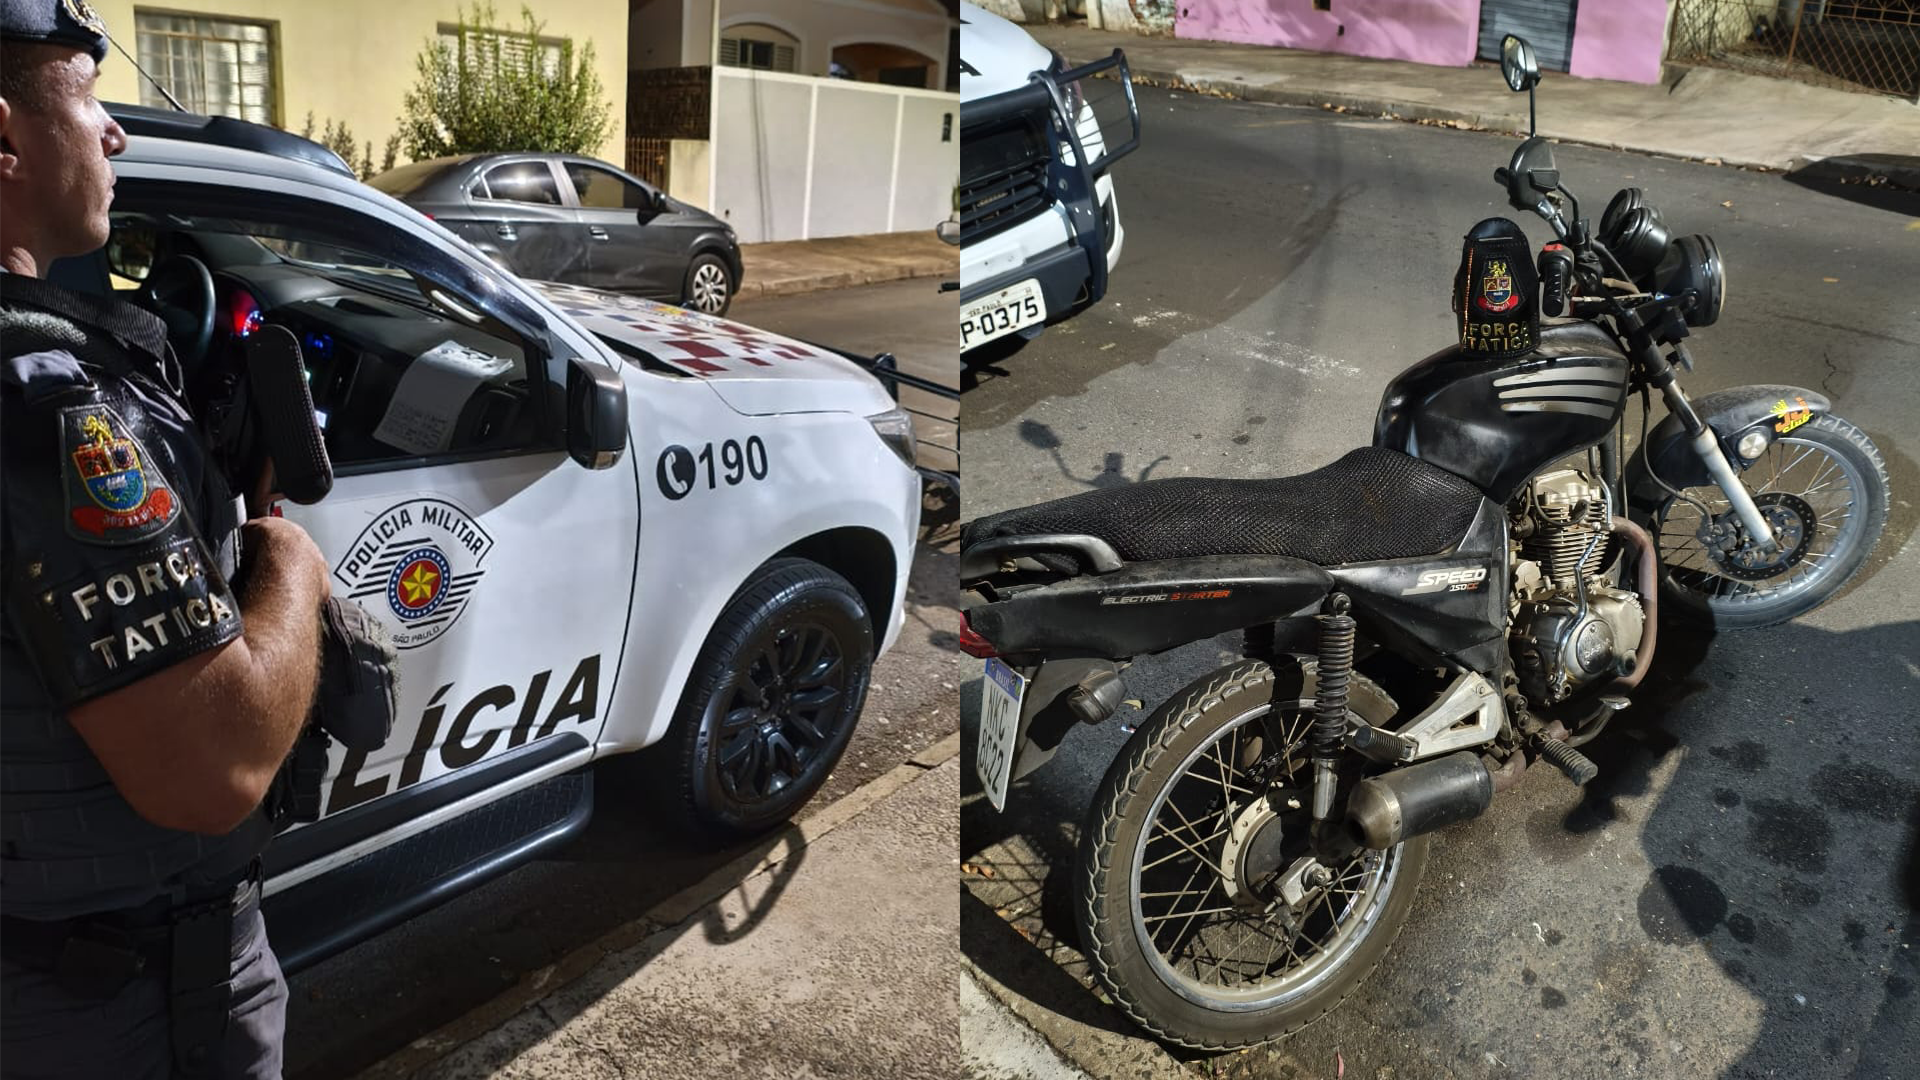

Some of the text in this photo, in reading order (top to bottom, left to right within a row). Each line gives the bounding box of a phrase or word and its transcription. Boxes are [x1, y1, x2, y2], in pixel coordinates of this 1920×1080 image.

[699, 435, 768, 490] 190
[345, 506, 484, 579] POLÍCIA MILITAR
[71, 547, 202, 622] FORÇ
[1102, 590, 1233, 605] ELECTRIC STARTER
[1416, 568, 1487, 587] SPEED
[90, 592, 233, 670] TATICA
[411, 625, 440, 643] PAULO
